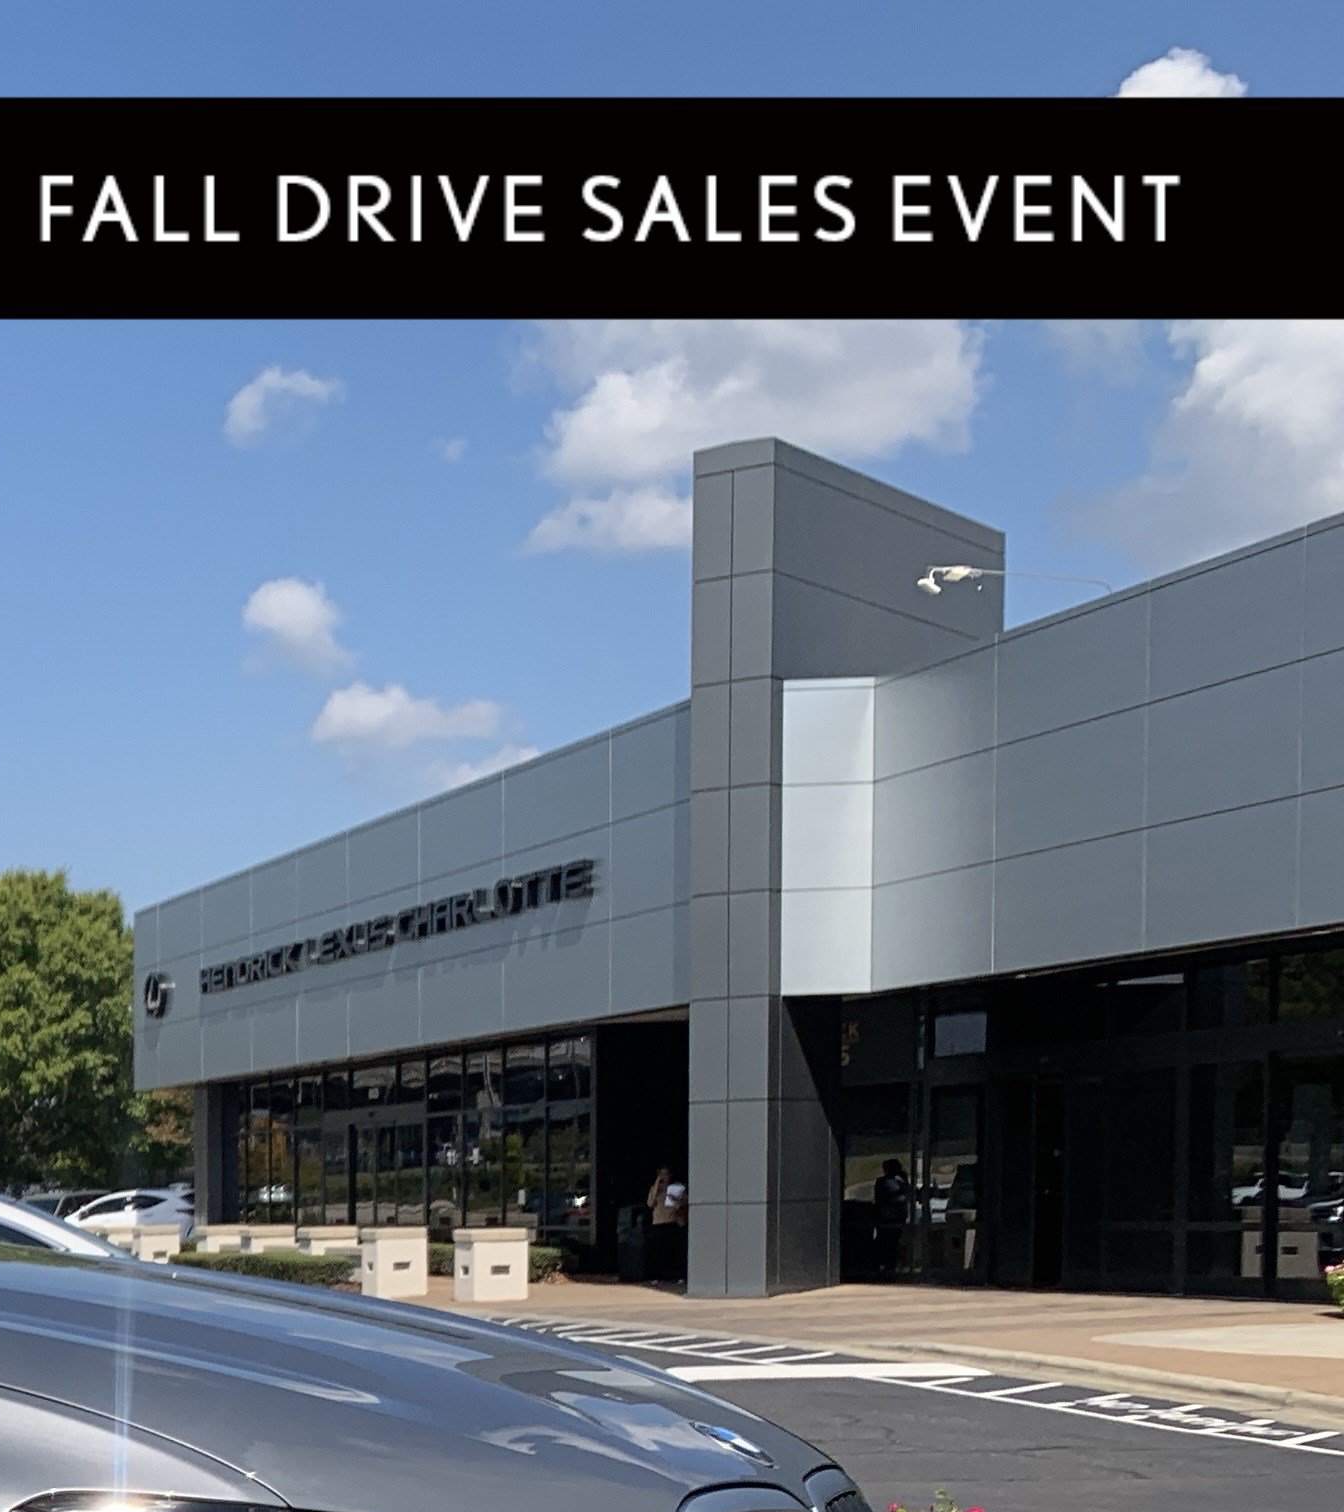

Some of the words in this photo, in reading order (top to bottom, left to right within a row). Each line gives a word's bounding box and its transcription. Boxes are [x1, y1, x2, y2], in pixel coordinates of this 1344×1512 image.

[200, 942, 306, 994] HENDRICK
[305, 914, 397, 967] LEXUS
[398, 859, 596, 941] CHARLOTTE
